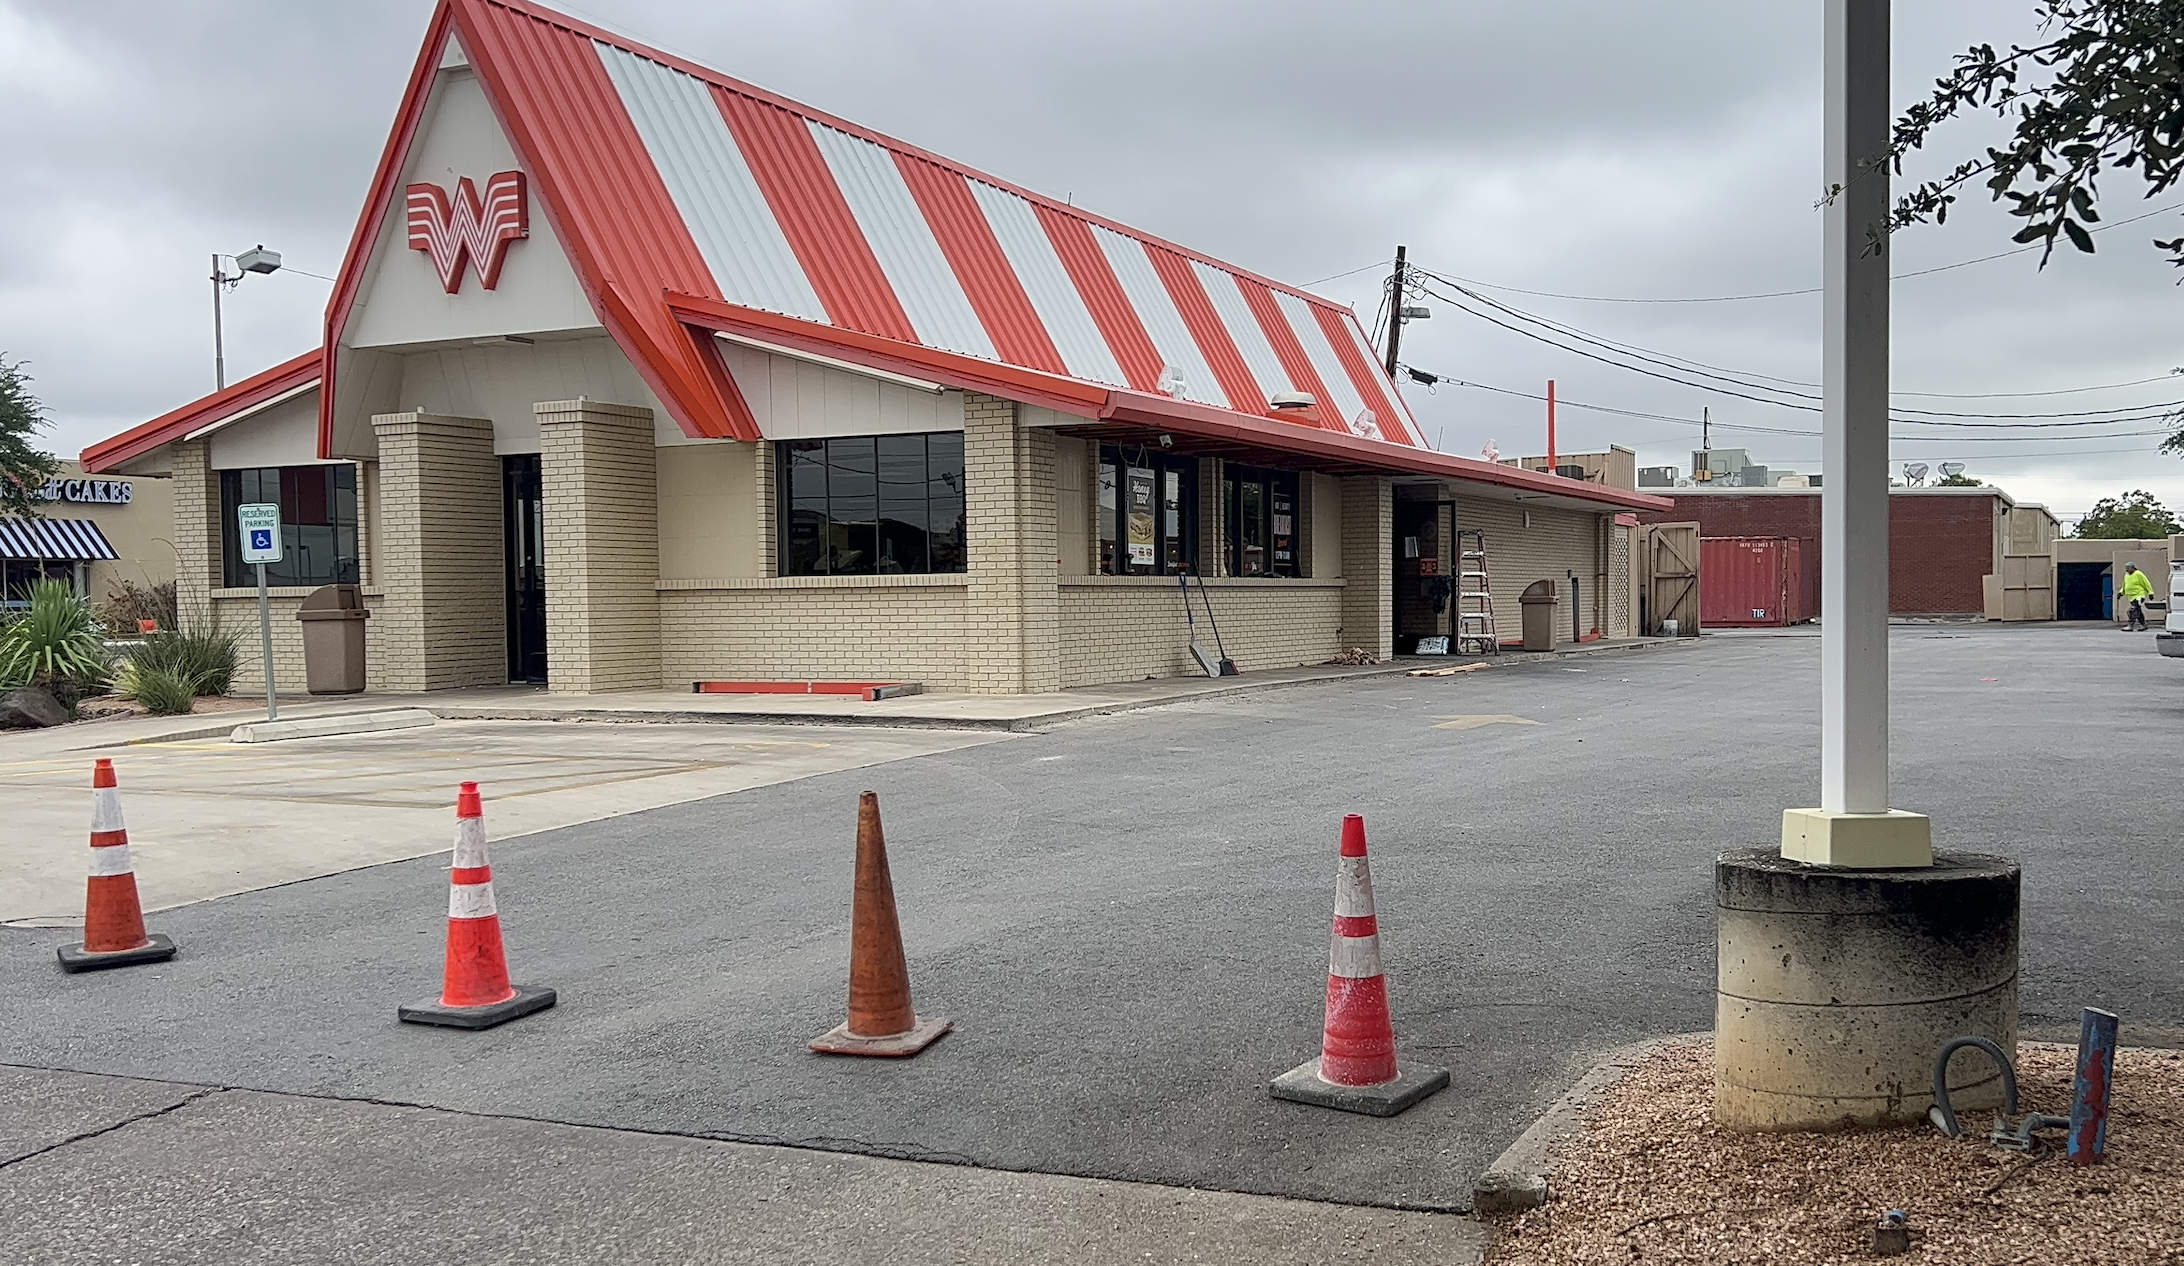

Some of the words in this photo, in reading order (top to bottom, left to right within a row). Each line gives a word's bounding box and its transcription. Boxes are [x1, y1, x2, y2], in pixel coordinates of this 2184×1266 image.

[407, 171, 529, 294] W
[65, 480, 134, 503] CAKES
[241, 510, 276, 518] RESERVED
[245, 520, 275, 528] PARKING
[1751, 608, 1765, 618] TIR
